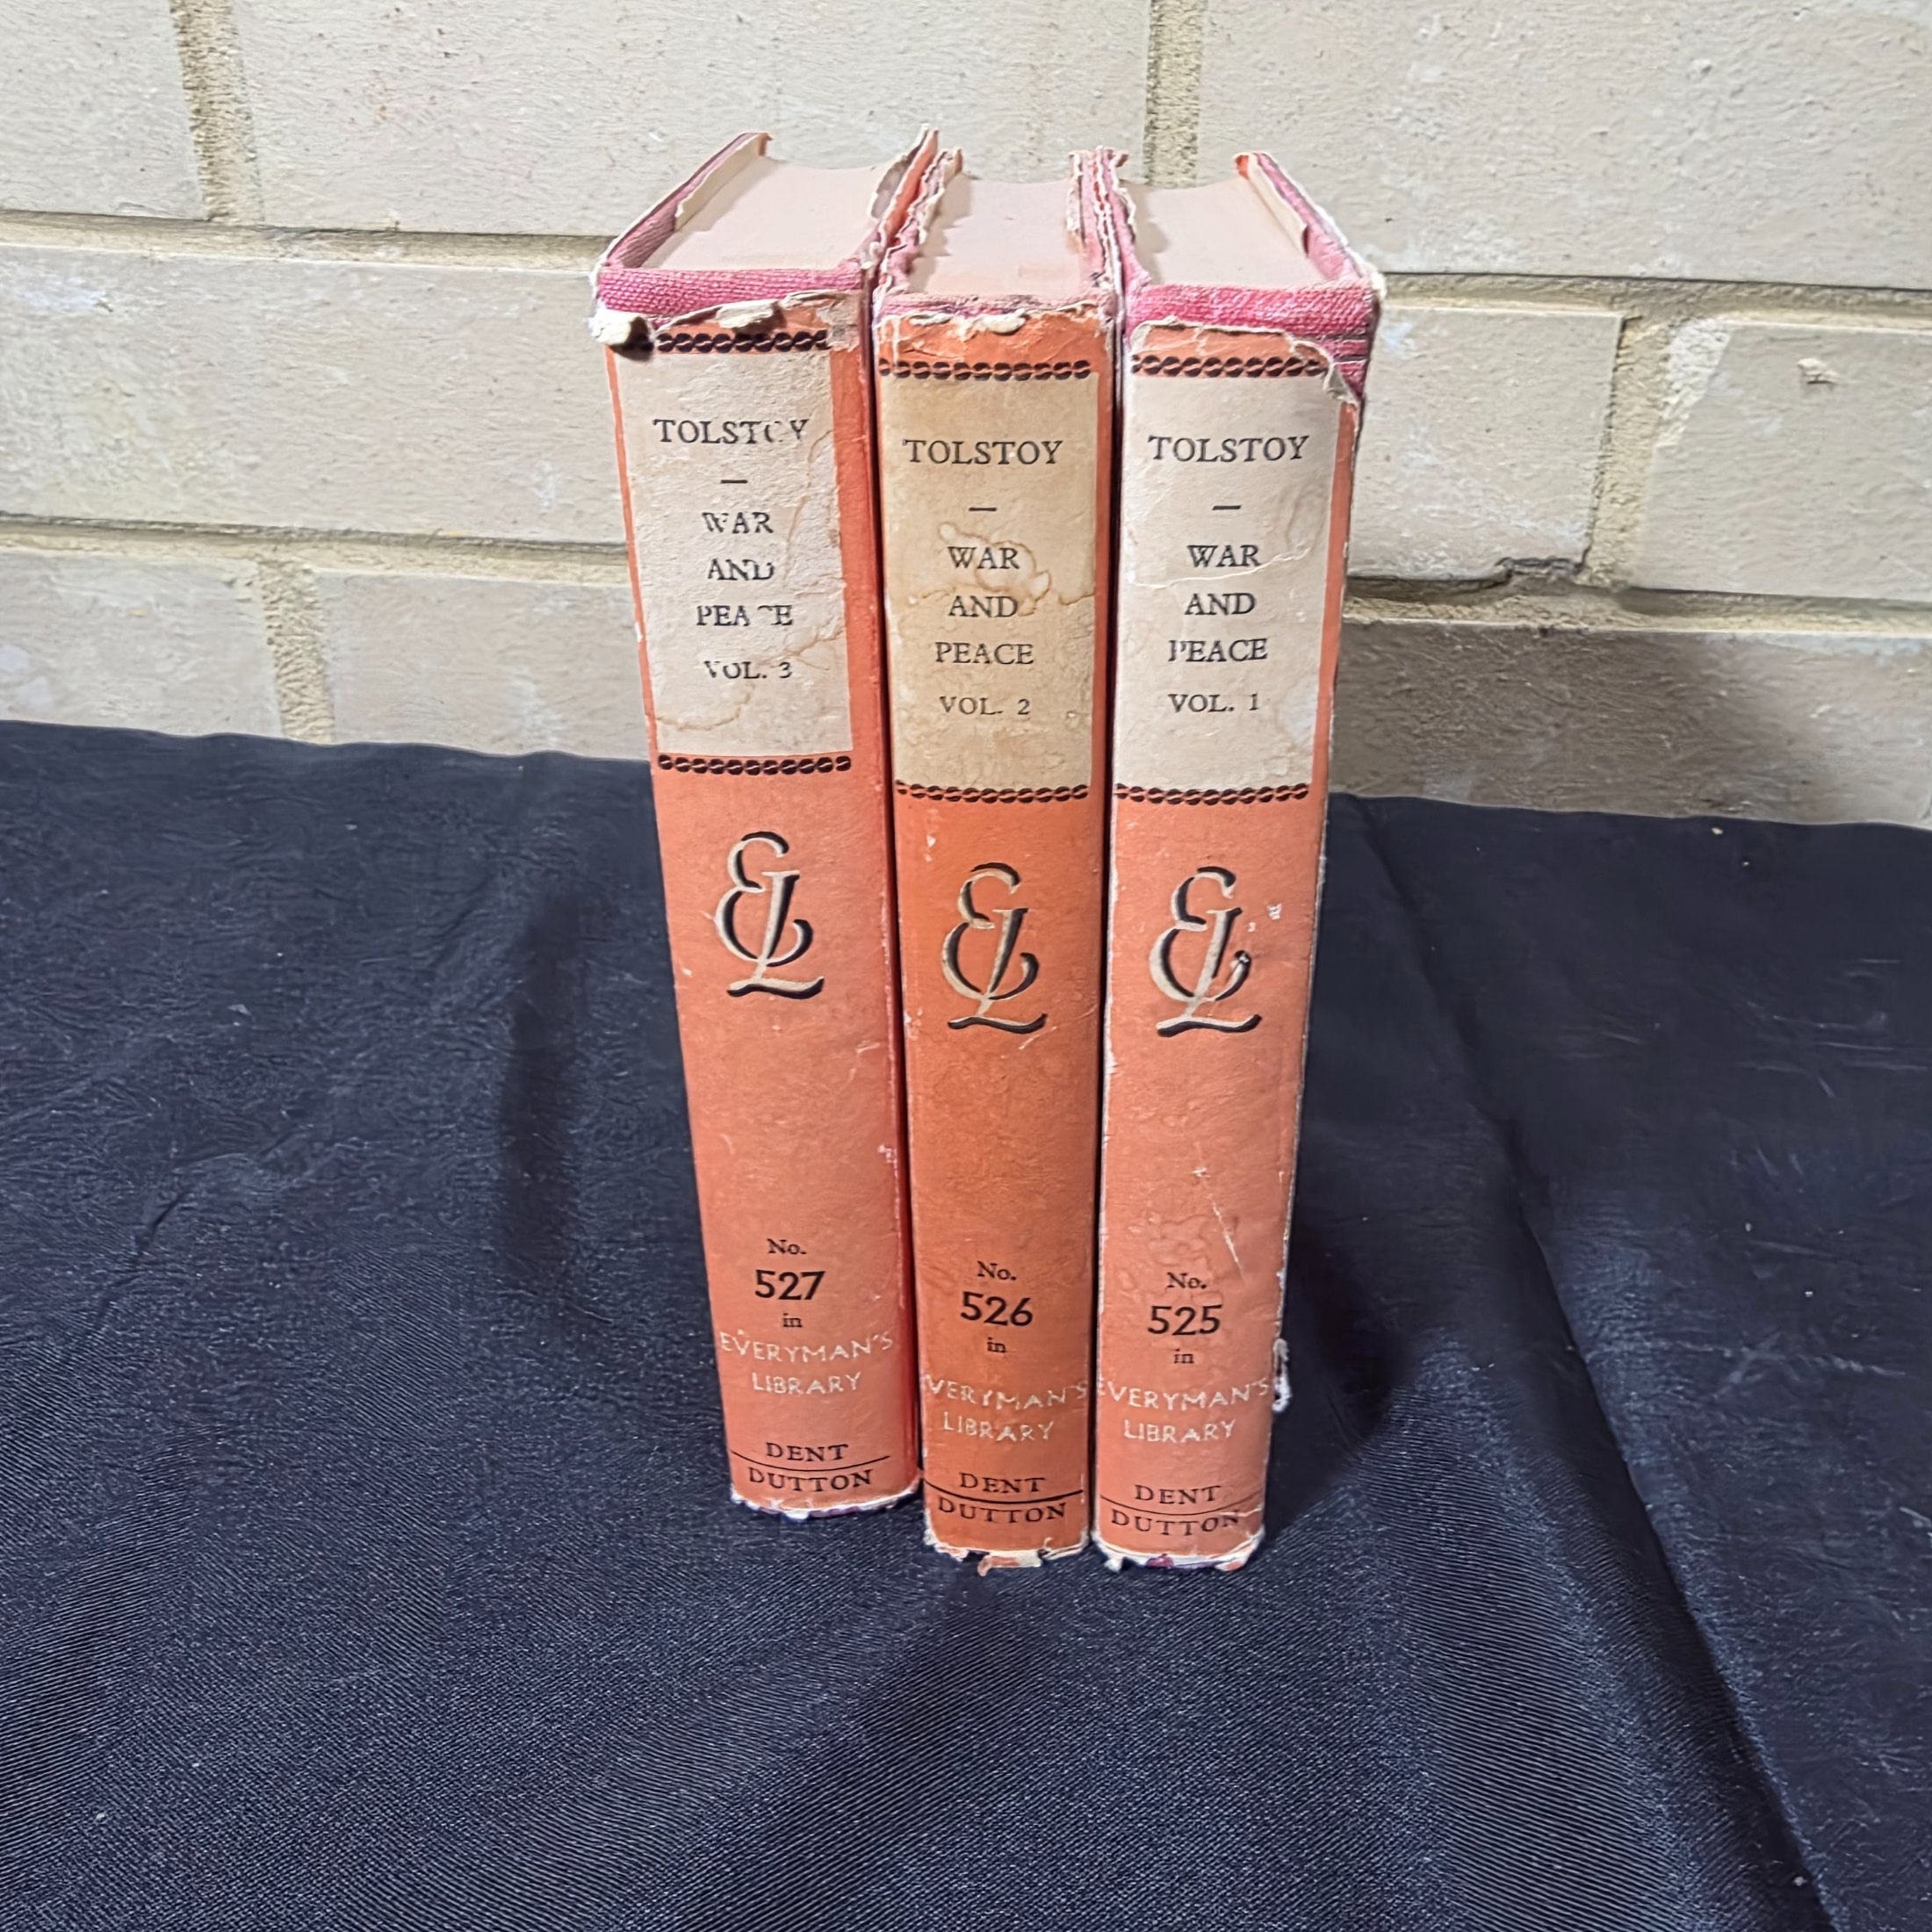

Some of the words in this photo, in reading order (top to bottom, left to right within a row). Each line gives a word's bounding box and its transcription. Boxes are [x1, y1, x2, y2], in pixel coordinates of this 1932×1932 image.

[904, 439, 1063, 465] TOLSTOY
[1148, 436, 1309, 461] TOLSTOY
[702, 511, 774, 534] WAR
[948, 546, 1020, 569] WAR
[1187, 544, 1262, 567] WAR
[707, 558, 775, 581] AND
[696, 604, 794, 627] PEAE
[948, 595, 1019, 618] AND
[1184, 593, 1257, 616] AND
[934, 641, 1035, 665] PEACE
[1168, 638, 1268, 662] PEACE
[703, 660, 768, 680] VOL.
[778, 661, 793, 680] 3
[940, 696, 1003, 716] VOL.
[1017, 698, 1031, 716] 2
[1167, 693, 1235, 712] VOL.
[1248, 693, 1260, 711] 1
[767, 1237, 807, 1255] No.
[977, 1260, 1017, 1281] No.
[1166, 1272, 1208, 1290] No.
[754, 1269, 826, 1301] 527
[782, 1312, 804, 1328] in
[960, 1291, 1034, 1327] 526
[1147, 1304, 1223, 1336] 525
[718, 1330, 893, 1363] EVERYMAN'S
[986, 1337, 1006, 1353] in
[1173, 1348, 1194, 1364] in
[751, 1372, 861, 1395] LIBRARY
[923, 1373, 1088, 1410] VERYMAN'S
[943, 1411, 1054, 1442] LIBRARY
[1123, 1418, 1236, 1443] LIBRARY
[766, 1442, 849, 1461] DENT
[748, 1467, 873, 1492] DUTTON
[959, 1472, 1046, 1493] DENT
[1135, 1484, 1222, 1504] DENT
[938, 1496, 1066, 1524] DUTTON
[1111, 1509, 1241, 1536] DUTTON
